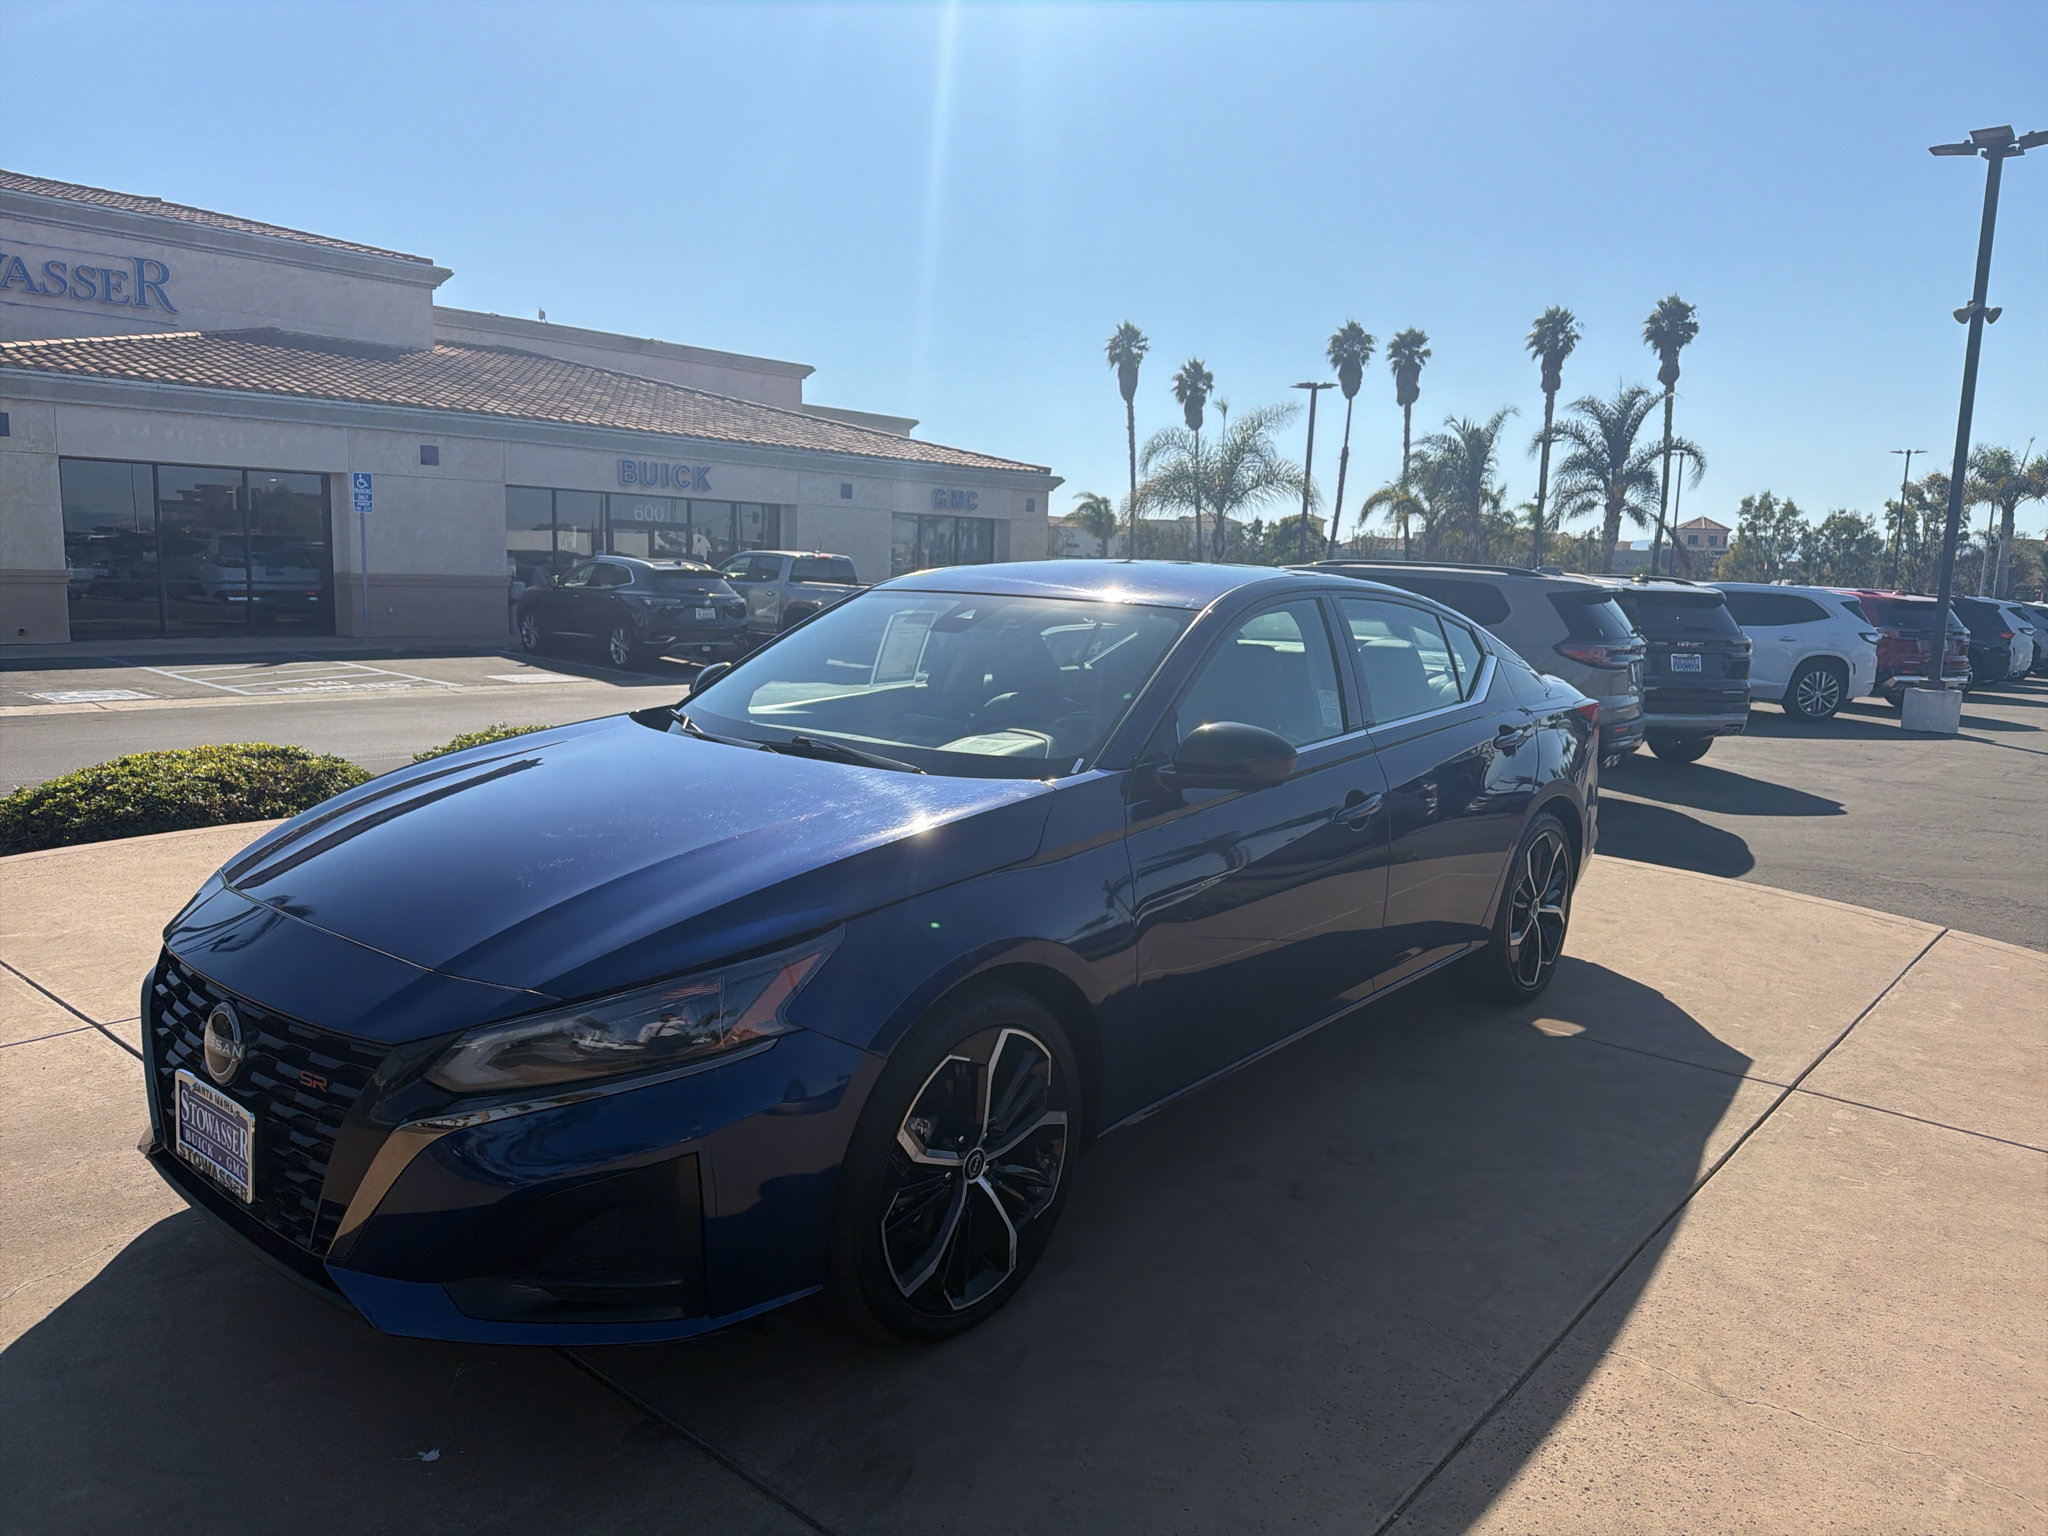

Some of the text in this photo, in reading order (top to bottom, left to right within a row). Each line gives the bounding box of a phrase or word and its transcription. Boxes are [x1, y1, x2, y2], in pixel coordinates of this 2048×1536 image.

[619, 459, 712, 491] BUICK
[633, 503, 664, 521] 600
[932, 487, 979, 511] GMC
[299, 1069, 328, 1093] SR
[180, 1088, 249, 1163] STOWASSER
[184, 1128, 246, 1181] BUICK GMC
[178, 1141, 249, 1201] STOWASSER
